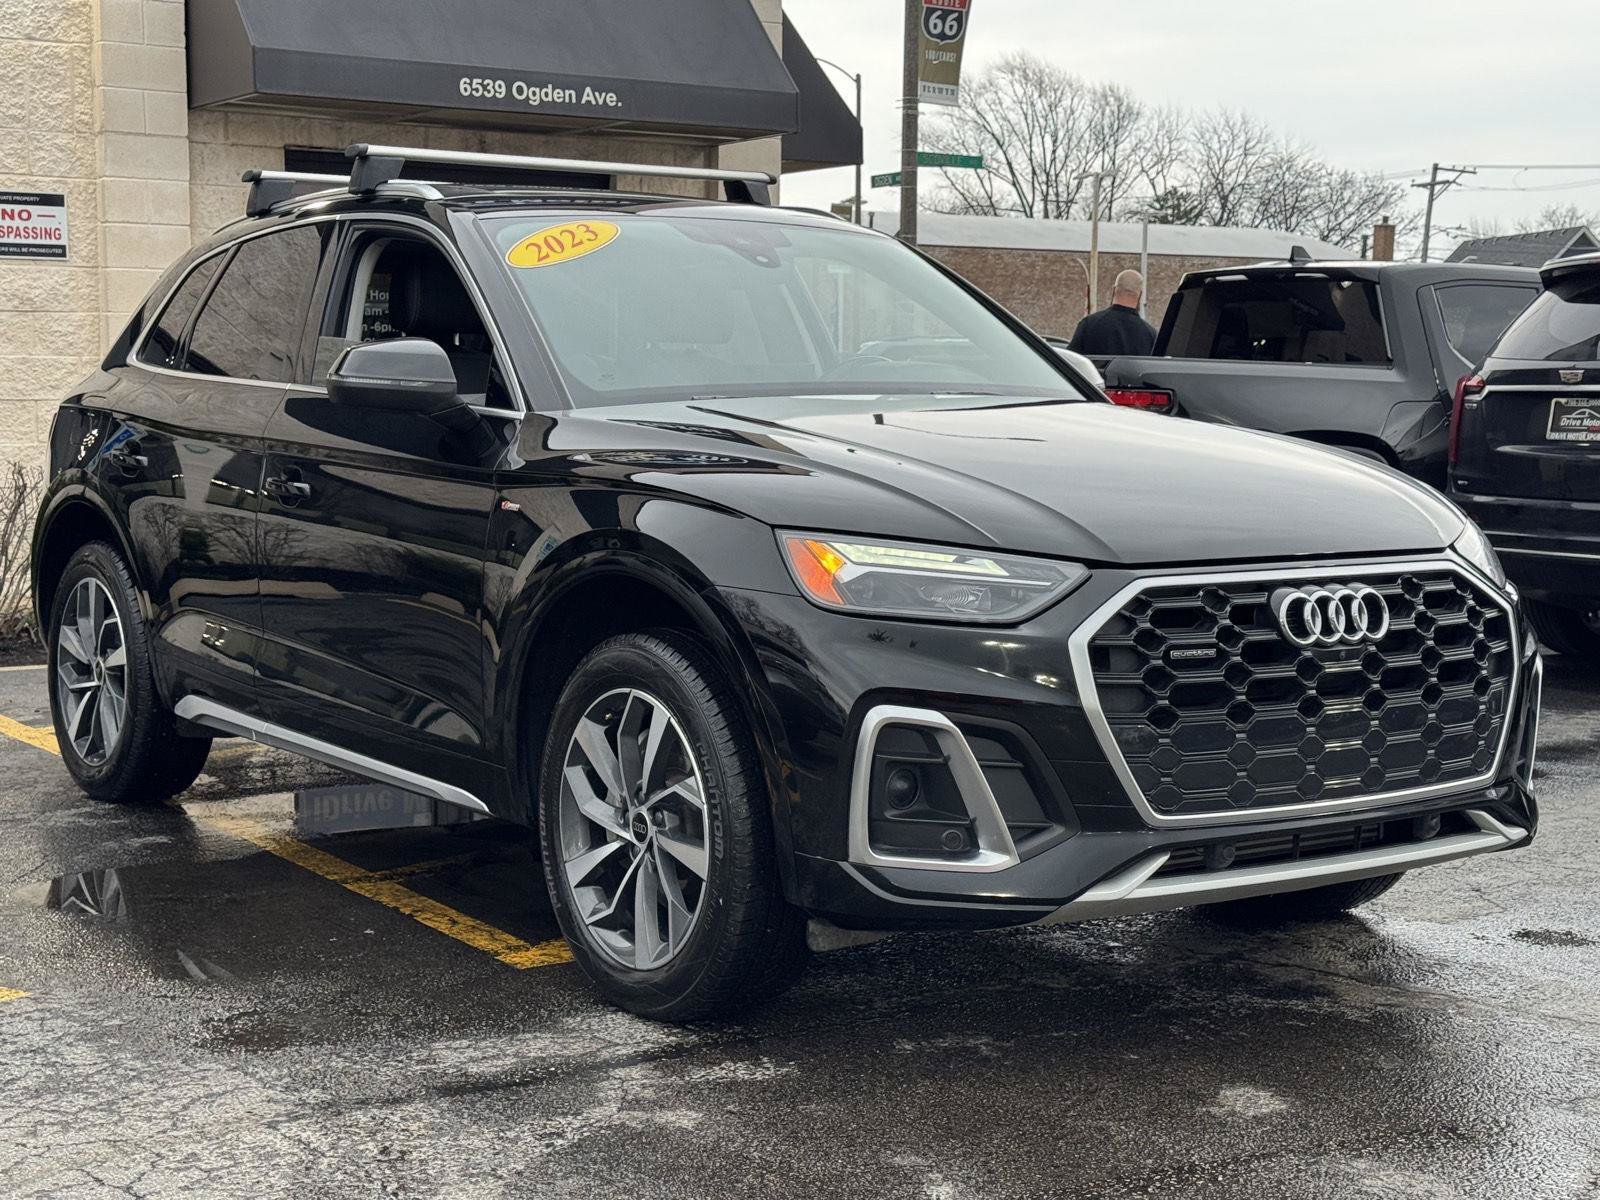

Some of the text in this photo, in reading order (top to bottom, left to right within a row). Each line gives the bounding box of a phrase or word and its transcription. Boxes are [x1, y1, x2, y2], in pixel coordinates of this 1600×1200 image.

[928, 10, 959, 36] 66
[459, 77, 623, 107] 6539 Ogden Ave.
[1, 208, 32, 222] NO
[525, 223, 599, 263] 2023
[1560, 417, 1582, 427] Drive
[1173, 650, 1215, 658] quattro
[696, 741, 724, 860] PHANTOM
